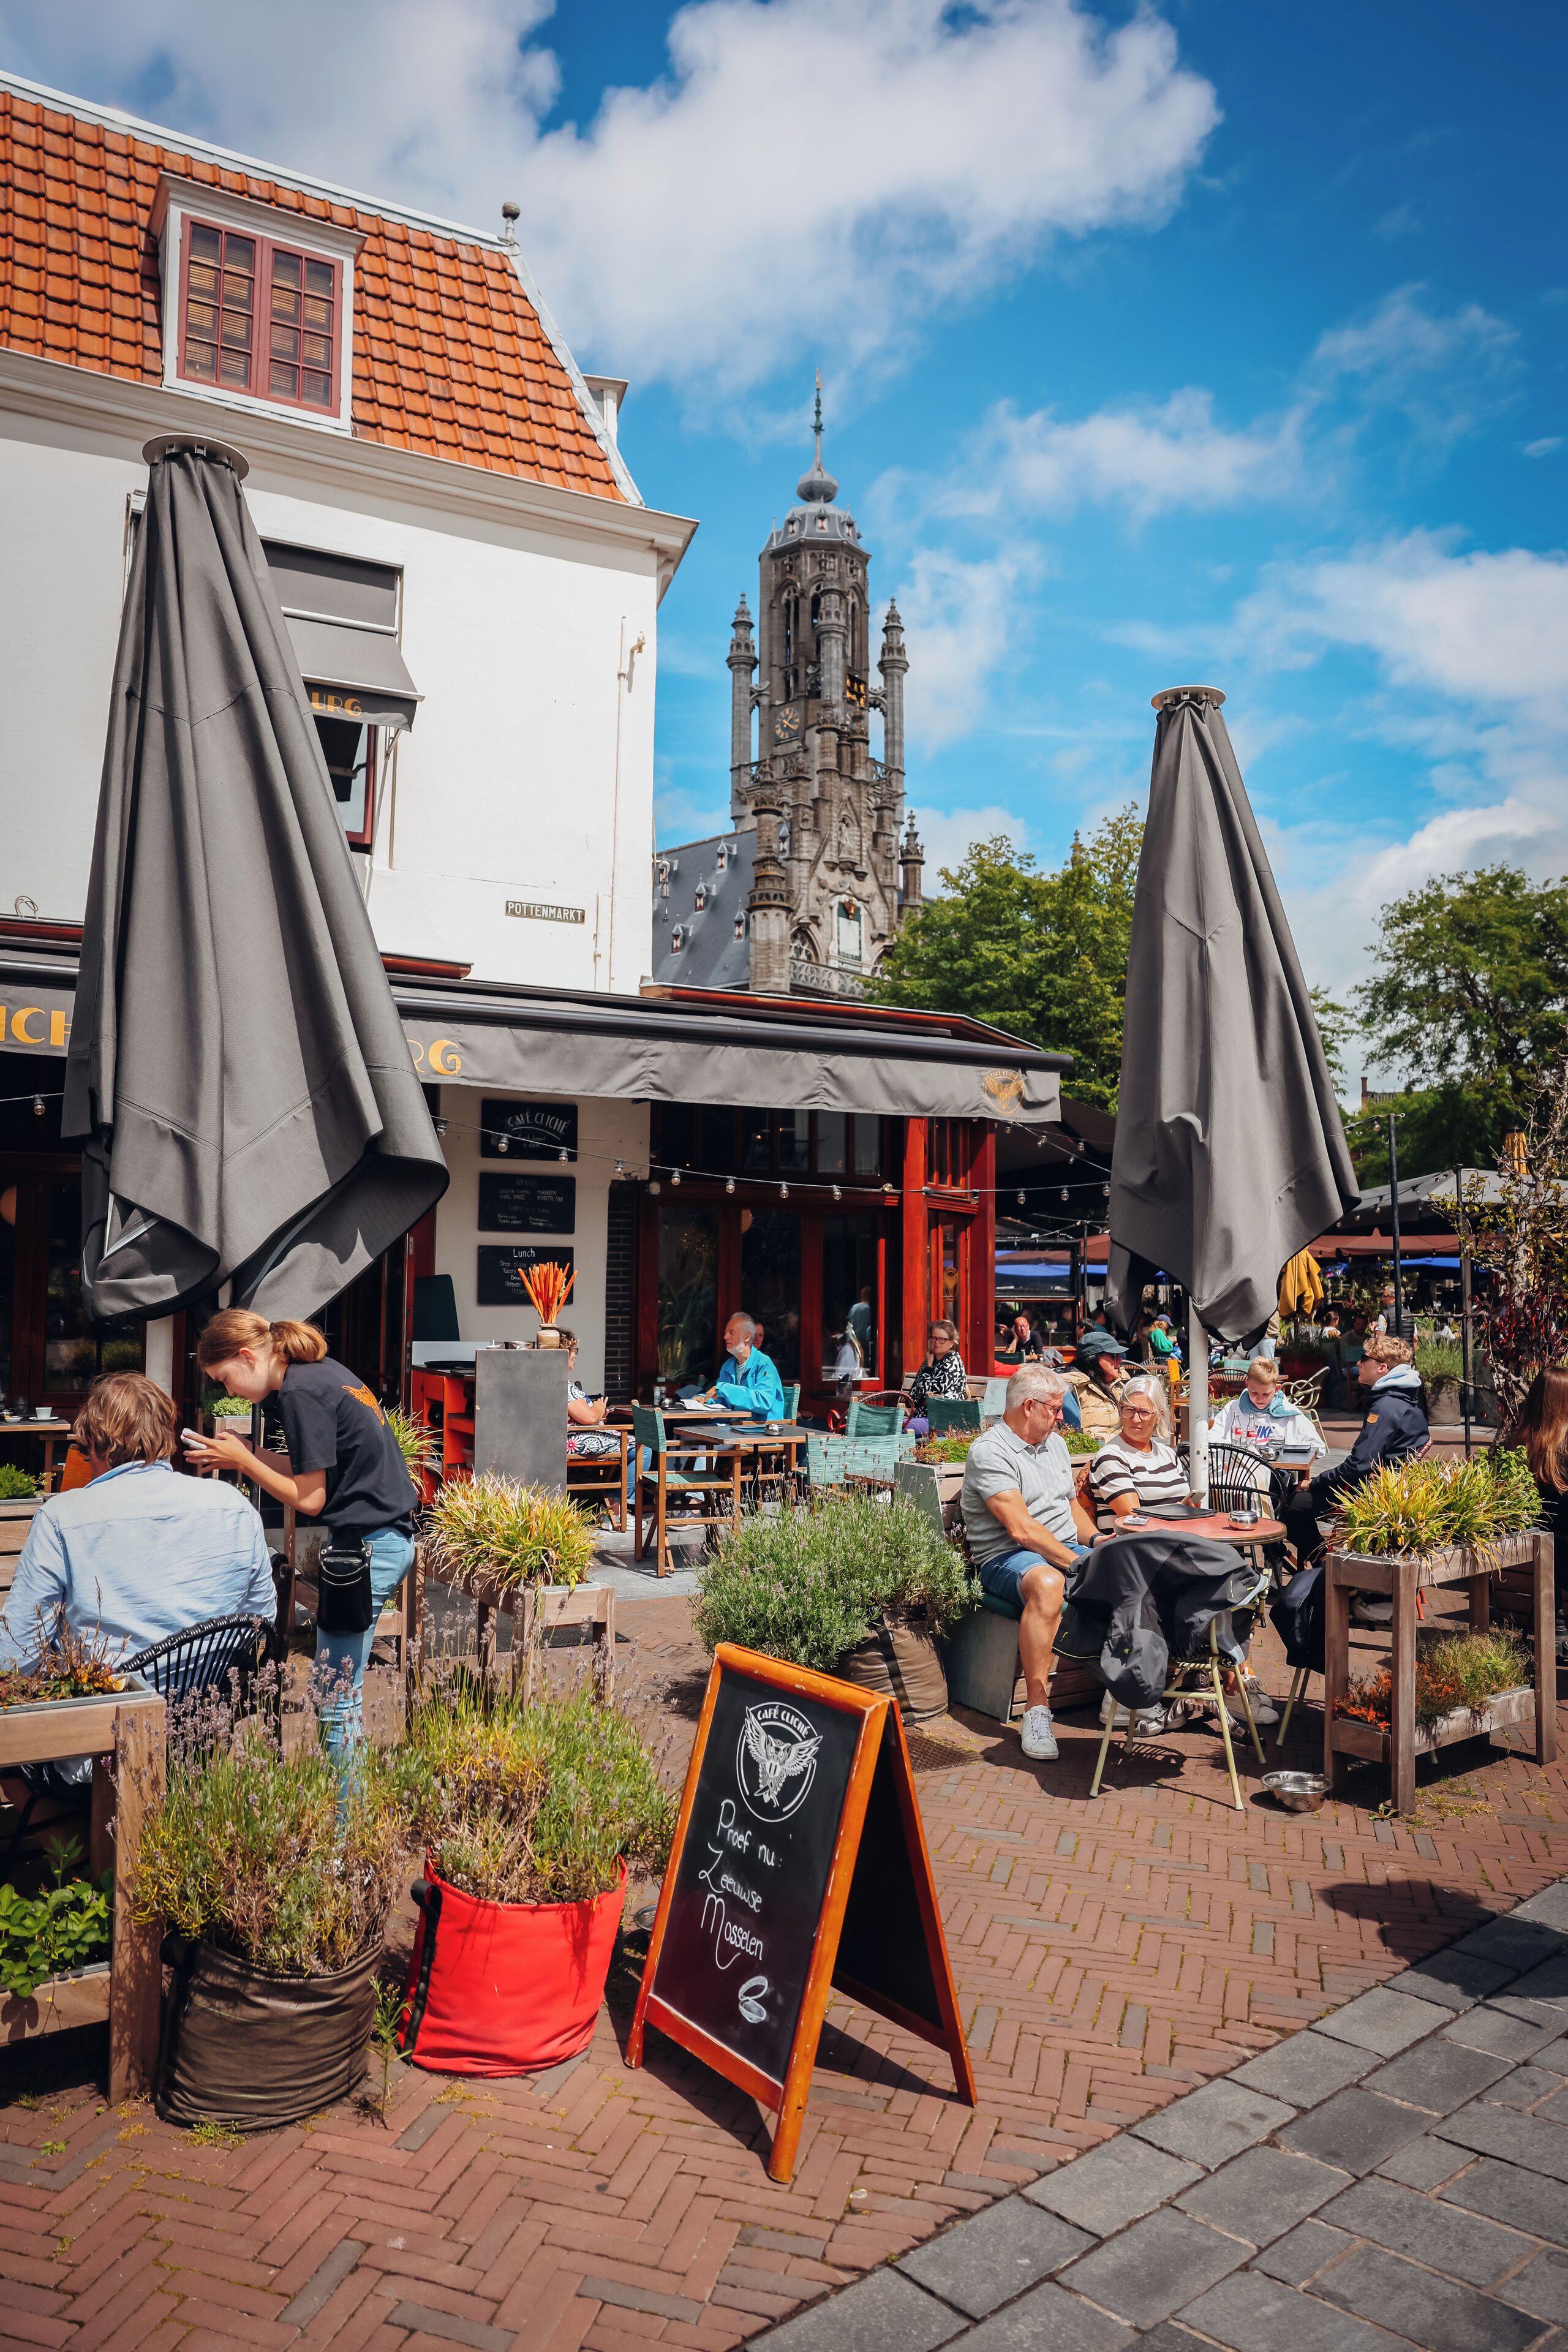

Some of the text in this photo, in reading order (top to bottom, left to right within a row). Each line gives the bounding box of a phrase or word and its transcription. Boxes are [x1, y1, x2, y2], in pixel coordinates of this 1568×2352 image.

[508, 902, 582, 921] POTTENMARKT
[508, 1109, 571, 1135] CAFÉ CLICHÉ
[513, 1248, 535, 1257] Lunch
[757, 1705, 810, 1738] CAFÉ CLICHÉ
[717, 1799, 752, 1853] Proef
[698, 1842, 762, 1912] Zeeuwse
[701, 1893, 763, 1970] Mosselen
